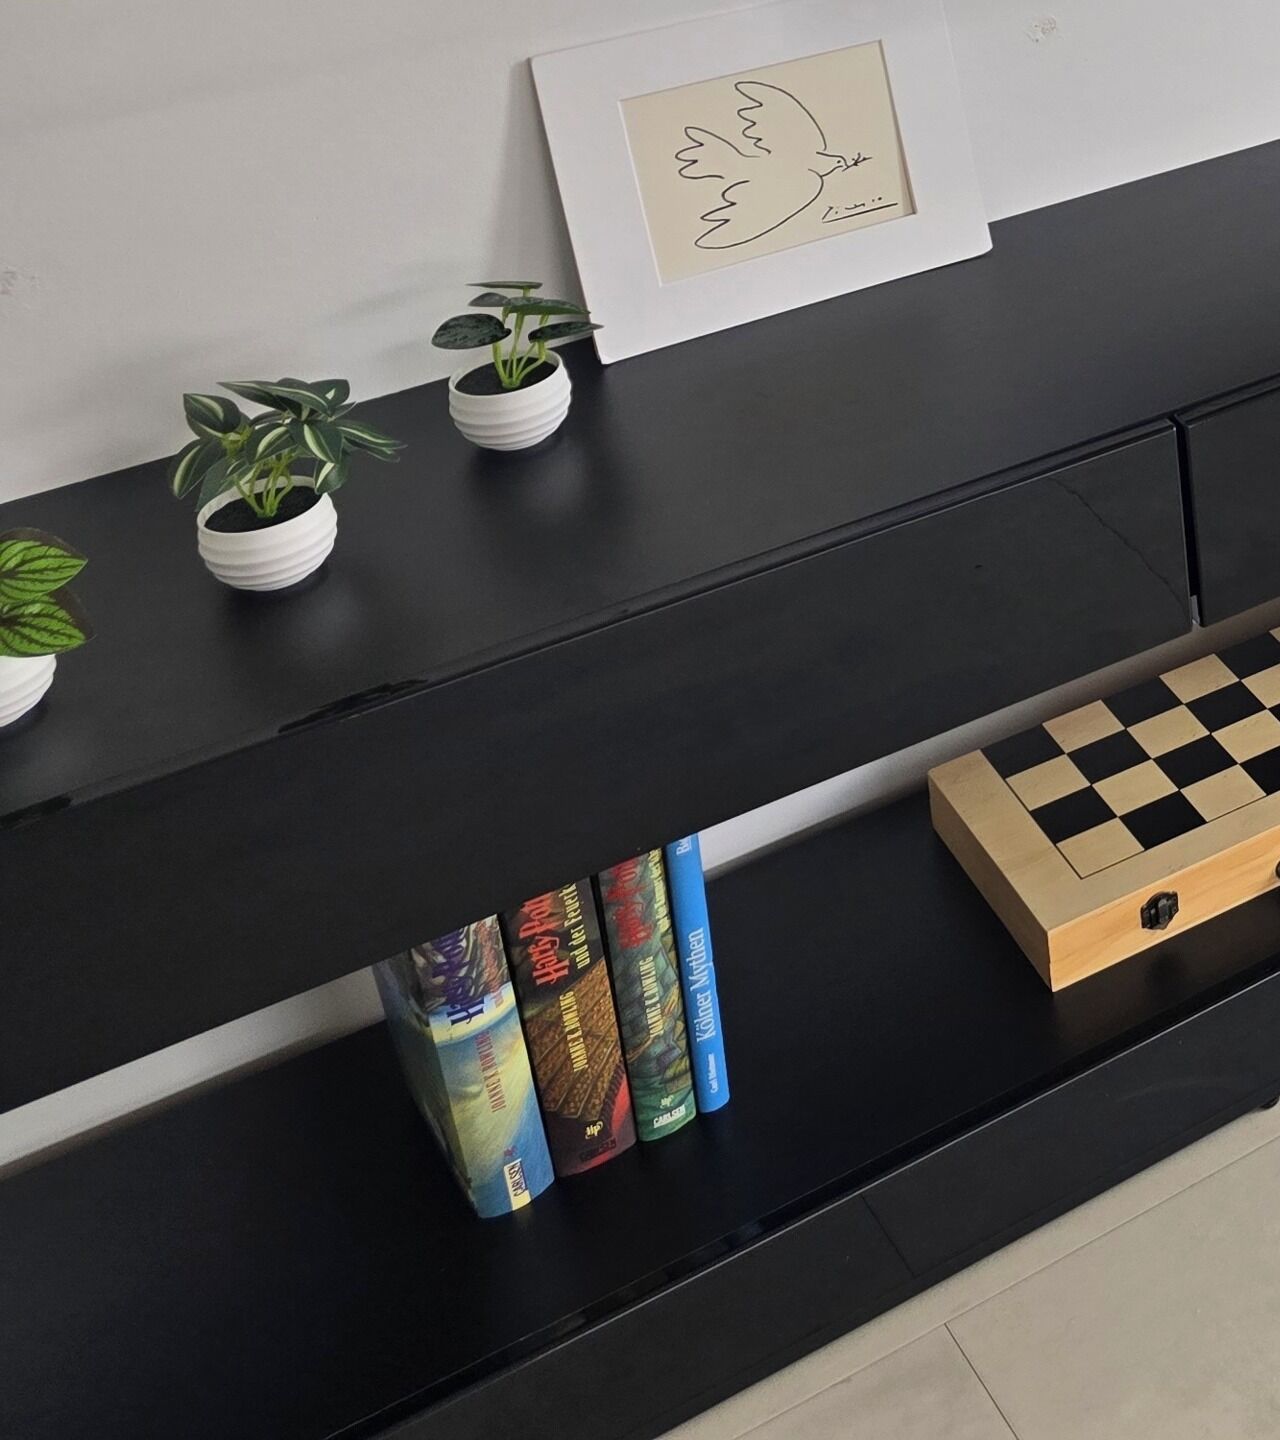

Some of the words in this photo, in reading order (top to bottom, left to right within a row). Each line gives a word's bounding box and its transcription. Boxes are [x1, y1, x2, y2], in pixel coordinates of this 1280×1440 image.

[567, 924, 587, 946] der
[528, 935, 570, 986] Harry
[569, 944, 591, 970] und
[687, 927, 714, 992] Mythen
[559, 991, 581, 1033] ROWLING
[694, 990, 716, 1044] Kölner
[568, 1038, 589, 1073] JOANNE
[485, 1078, 507, 1113] JOANNE
[508, 1160, 529, 1197] CARLSEN
